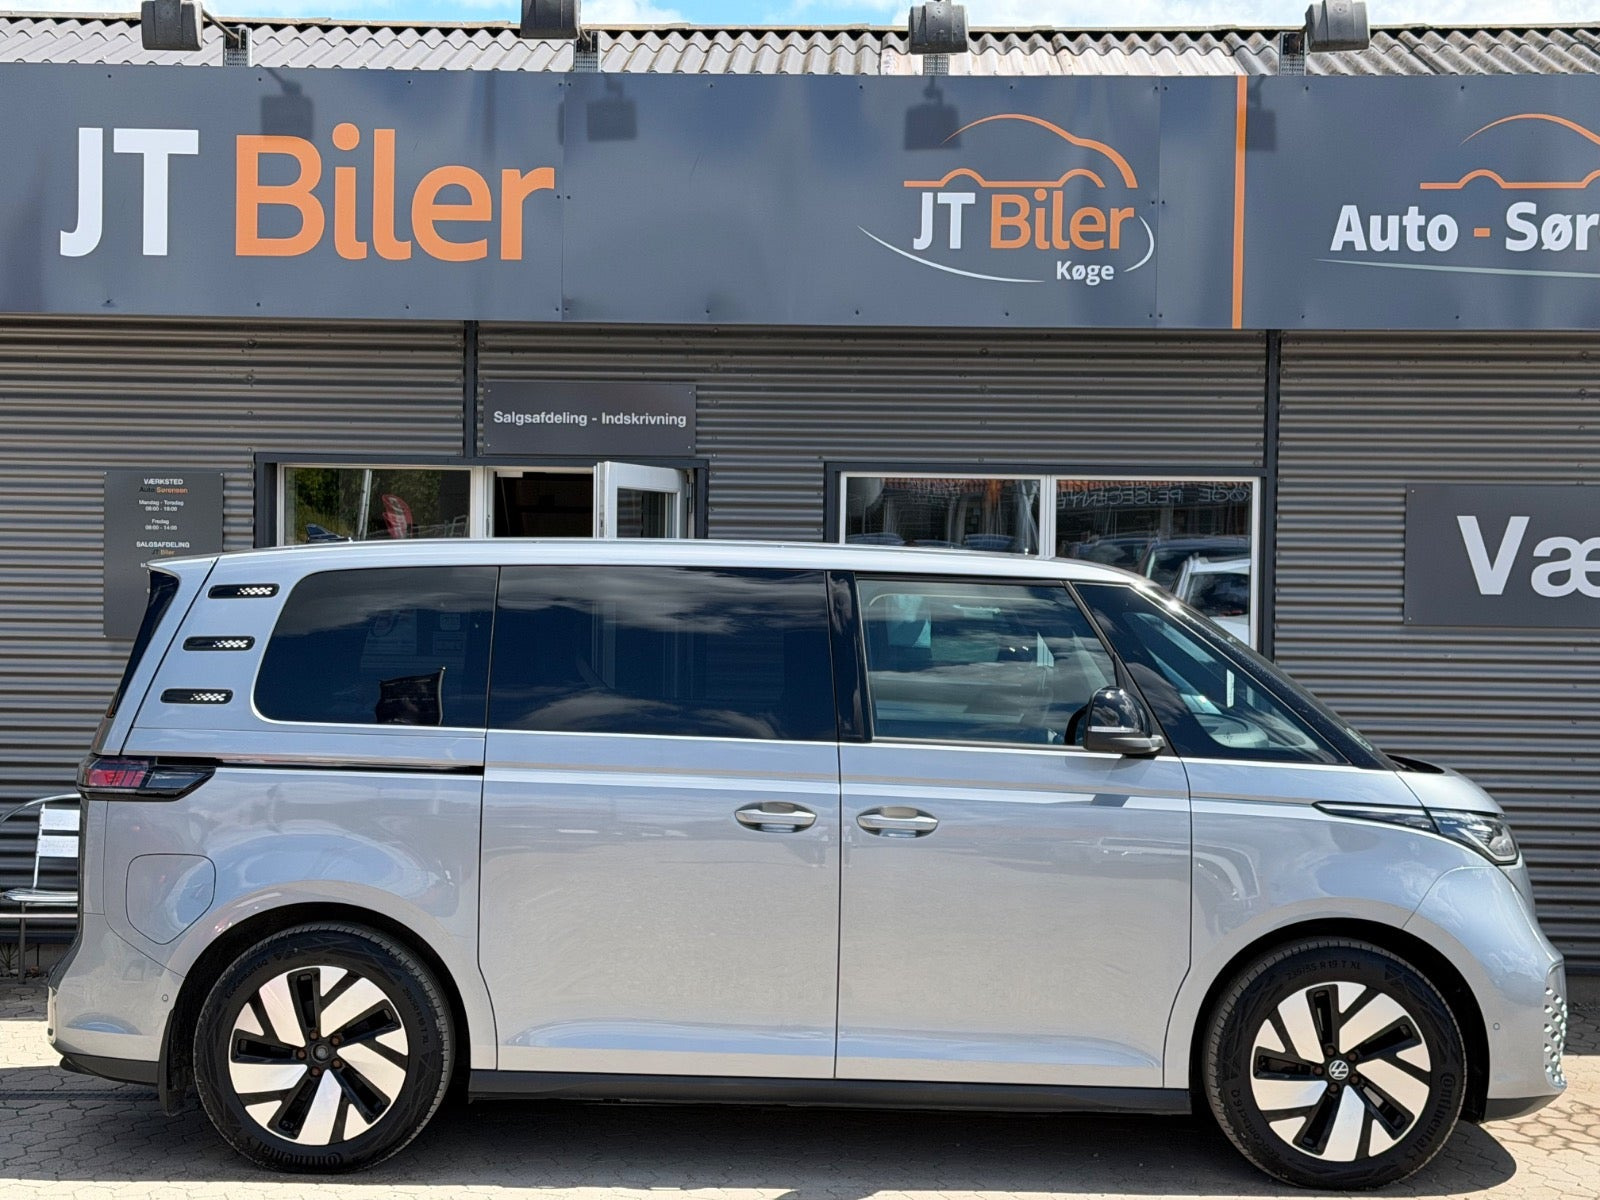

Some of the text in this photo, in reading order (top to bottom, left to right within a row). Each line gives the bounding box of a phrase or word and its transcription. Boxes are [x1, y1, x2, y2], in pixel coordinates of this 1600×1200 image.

[60, 122, 555, 262] JT Biler
[913, 188, 1135, 250] JT Biler
[1330, 201, 1600, 252] Auto - Sør
[1056, 261, 1115, 286] Køge
[493, 411, 588, 427] Salgsafdeling
[601, 412, 687, 428] Indskrivning
[136, 541, 190, 549] SALGSAFDELING
